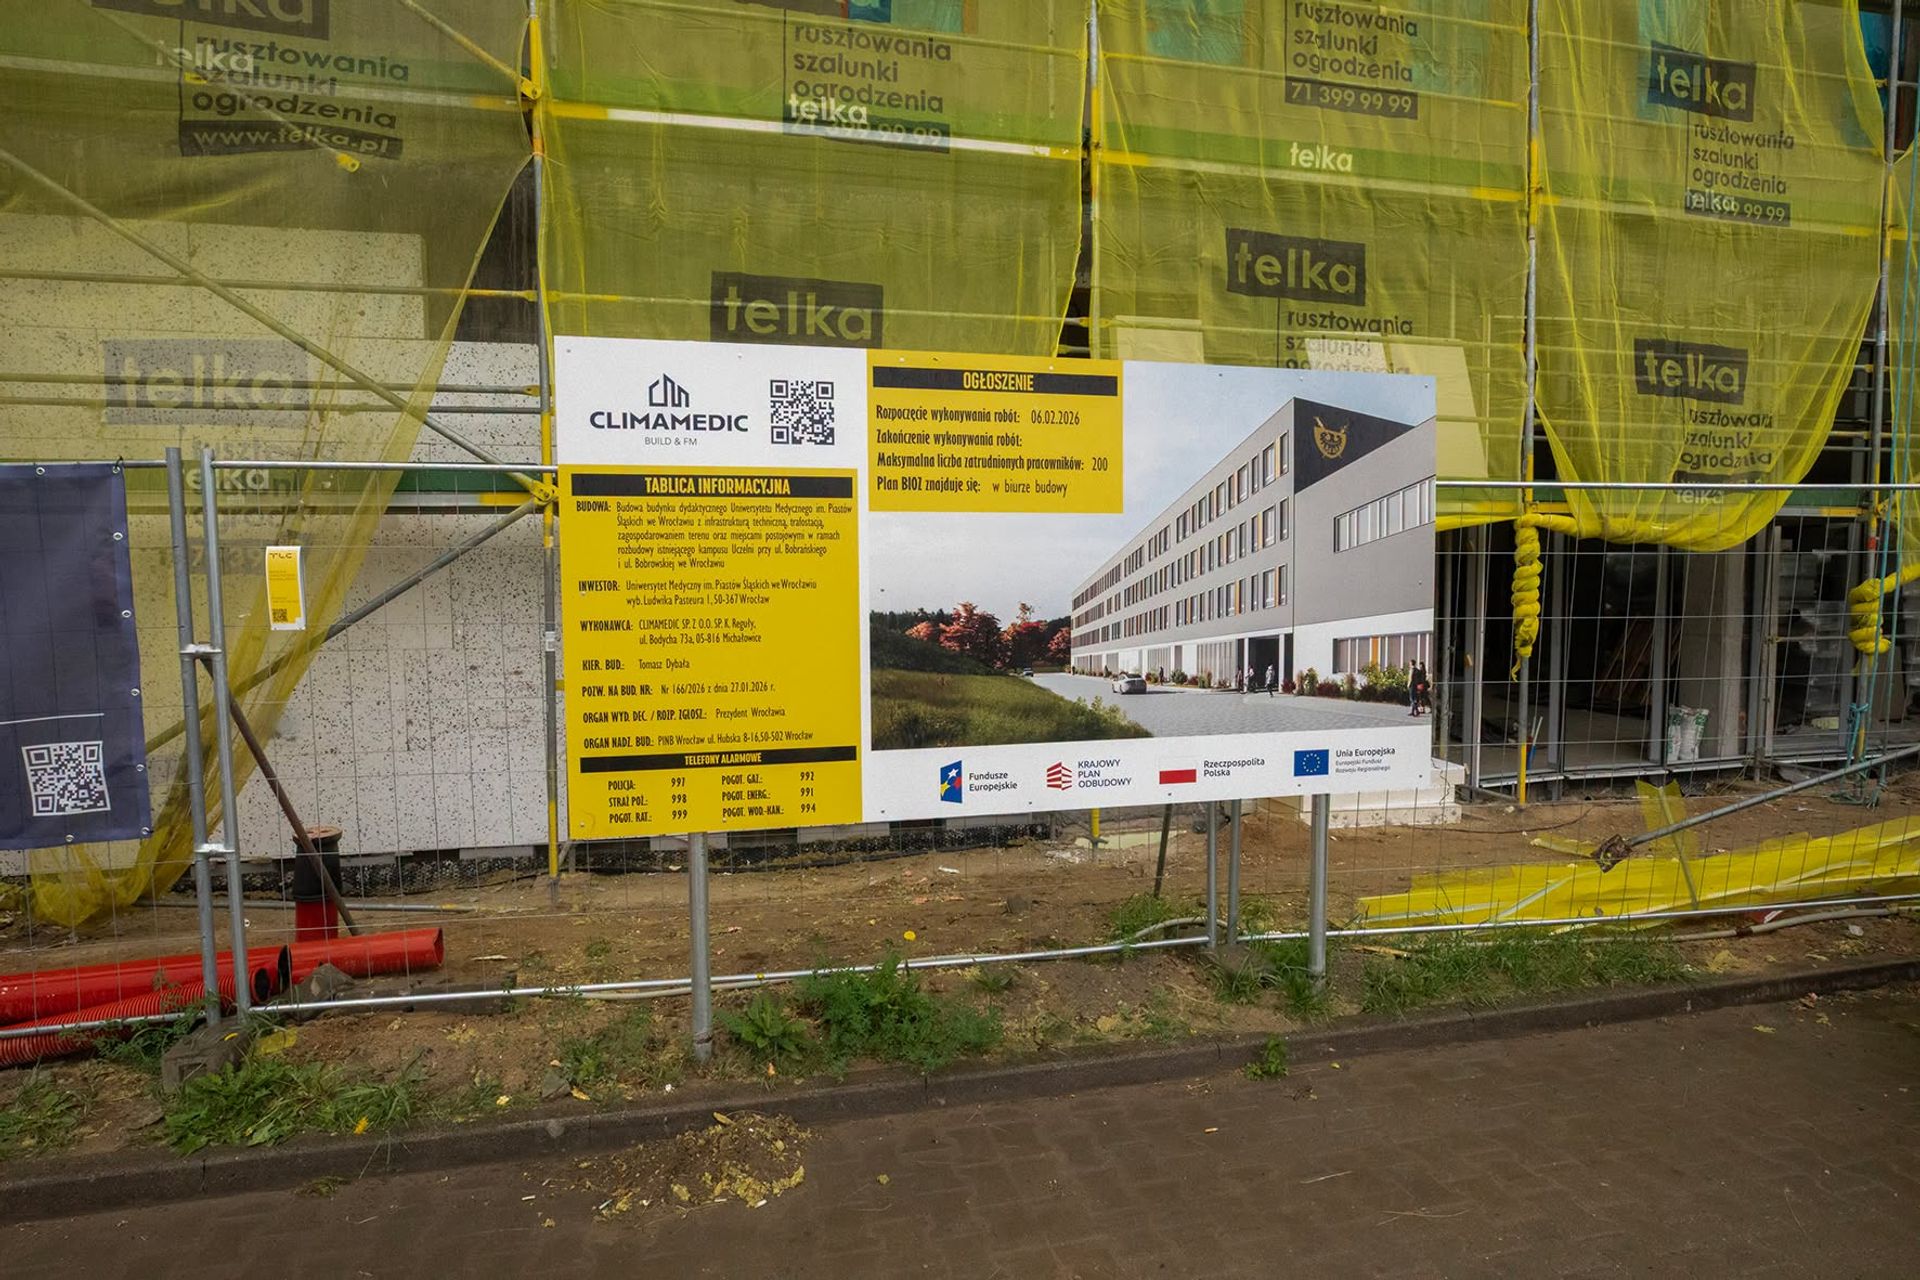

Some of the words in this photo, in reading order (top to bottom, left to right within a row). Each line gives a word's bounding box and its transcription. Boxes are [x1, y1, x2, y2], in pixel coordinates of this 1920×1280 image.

[1295, 3, 1418, 37] rusztowania
[795, 25, 951, 61] rusztowania
[1294, 30, 1378, 55] szalunki
[196, 36, 409, 82] rusztowania
[793, 53, 898, 82] szalunki
[1293, 51, 1413, 83] ogrodzenia
[1657, 55, 1746, 112] telka
[794, 80, 943, 113] ogrodzenia
[1292, 83, 1313, 100] 71
[1319, 85, 1357, 106] 399
[1361, 92, 1383, 109] 99
[1389, 95, 1411, 113] 99
[192, 91, 397, 130] ogrodzenia
[789, 93, 868, 124] telka
[193, 126, 389, 155] www.telka.pl
[1694, 123, 1794, 150] rusztowania
[1290, 142, 1352, 173] telka
[1693, 147, 1759, 170] szalunki
[1693, 166, 1786, 195] ogrodzenia
[1234, 242, 1356, 293] telka
[724, 285, 873, 341] telka
[1288, 310, 1412, 335] rusztowania
[1645, 350, 1740, 393] telka
[119, 355, 294, 410] telka
[963, 372, 1034, 391] OGŁOSZENIE
[590, 411, 748, 432] CLIMAMEDIC
[876, 404, 927, 422] Rozpoczęcie
[931, 405, 991, 425] wykonywania
[994, 407, 1020, 423] robót:
[1031, 410, 1080, 425] 06.02.2026
[644, 436, 672, 446] BUILD
[674, 437, 681, 446] &
[684, 437, 697, 446] FM
[877, 428, 930, 445] Zakończenie
[934, 429, 993, 448] wykonywania
[997, 432, 1022, 447] robót:
[877, 453, 935, 469] Maksymalna
[937, 454, 962, 469] liczba
[964, 454, 1024, 472] zatrudnionych
[1027, 455, 1084, 473] pracowników:
[1092, 457, 1108, 471] 200
[645, 477, 695, 493] TABLICA
[698, 478, 790, 495] INFORMACYJNA
[877, 476, 898, 492] Plan
[901, 477, 922, 491] BIOZ
[925, 477, 963, 493] znajduje
[966, 479, 980, 494] się:
[993, 482, 1000, 492] w
[1004, 479, 1030, 493] biurze
[1035, 479, 1067, 498] budowy
[576, 501, 611, 512] BUDOWA:
[617, 501, 643, 512] Budowa
[647, 502, 675, 515] budynku
[680, 502, 727, 516] dydaktycznego
[731, 503, 771, 515] Uniwersytetu
[775, 503, 812, 516] Medycznego
[828, 503, 852, 513] Piastów
[617, 513, 643, 529] Śląskich
[658, 516, 694, 526] Wrocławiu
[618, 531, 684, 543] zagospodarowaniem
[689, 531, 709, 540] terenu
[713, 532, 726, 540] oraz
[731, 530, 761, 542] miejscami
[766, 530, 804, 542] postojowymi
[817, 531, 840, 540] ramach
[618, 544, 654, 556] rozbudowy
[658, 544, 695, 557] istniejącego
[699, 544, 728, 557] kampusu
[732, 544, 754, 554] Uczelni
[758, 547, 771, 557] przy
[635, 558, 674, 570] Bobrowskiej
[690, 558, 724, 568] Wrocławiu
[579, 580, 620, 591] INWESTOR:
[626, 580, 667, 592] Uniwersytet
[669, 580, 700, 592] Medyczny
[715, 579, 741, 590] Piastów
[743, 577, 769, 592] Śląskich
[781, 579, 816, 589] Wrocławiu
[626, 595, 642, 607] wyb.
[644, 595, 672, 605] Ludwika
[675, 595, 704, 605] Pasteura
[714, 594, 738, 604] 50-367
[740, 594, 769, 604] Wrocław
[580, 620, 632, 631] WYKONAWCA:
[639, 619, 679, 629] CLIMAMEDIC
[650, 634, 677, 646] Bodycha
[680, 633, 694, 644] 73a,
[696, 633, 720, 643] 05-816
[723, 633, 761, 642] Michałowice
[583, 660, 602, 670] KIER.
[606, 659, 624, 670] BUD.:
[639, 659, 662, 669] Tomasz
[666, 659, 689, 671] Dybała
[582, 686, 605, 696] POZW.
[608, 686, 618, 696] NA
[621, 685, 637, 695] BUD.
[640, 685, 652, 695] NR:
[661, 684, 670, 694] Nr
[673, 683, 705, 694] 166/2026
[714, 683, 728, 692] dnia
[731, 681, 768, 692] 27.01.2026
[583, 711, 608, 723] ORGAN
[611, 711, 630, 722] WYD.
[633, 711, 647, 721] DEC.
[657, 710, 676, 720] ROZP.
[716, 708, 748, 720] Prezydent
[751, 707, 785, 717] Wrocławia
[584, 737, 609, 749] ORGAN
[612, 737, 632, 747] NADZ.
[635, 736, 654, 746] BUD.:
[658, 736, 674, 745] PINB
[675, 735, 705, 745] Wrocław
[718, 734, 741, 743] Hubska
[784, 730, 813, 740] Wrocław
[684, 755, 720, 765] TELEFONY
[721, 752, 761, 763] ALARMOWE
[1336, 749, 1353, 757] Unia
[1355, 747, 1395, 757] Europejska
[1078, 759, 1121, 769] KRAJOWY
[1204, 758, 1265, 770] Rzeczpospolita
[1204, 768, 1230, 777] Polska
[722, 774, 745, 785] POGOT.
[747, 774, 763, 783] GAZ.:
[800, 771, 814, 781] 992
[969, 771, 1008, 781] Fundusze
[1078, 770, 1100, 778] PLAN
[1078, 778, 1132, 788] ODBUDOWY
[608, 780, 636, 790] POLICJA:
[671, 777, 685, 787] 997
[969, 781, 1018, 792] Europejskie
[609, 796, 629, 807] STRAŻ
[672, 794, 687, 803] 998
[722, 790, 745, 801] POGOT.
[747, 789, 771, 799] ENERG.:
[800, 787, 813, 797] 991
[609, 813, 633, 823] POGOT.
[635, 812, 652, 822] RAT.:
[672, 810, 688, 820] 999
[723, 807, 745, 817] POGOT.
[801, 803, 816, 813] 994
